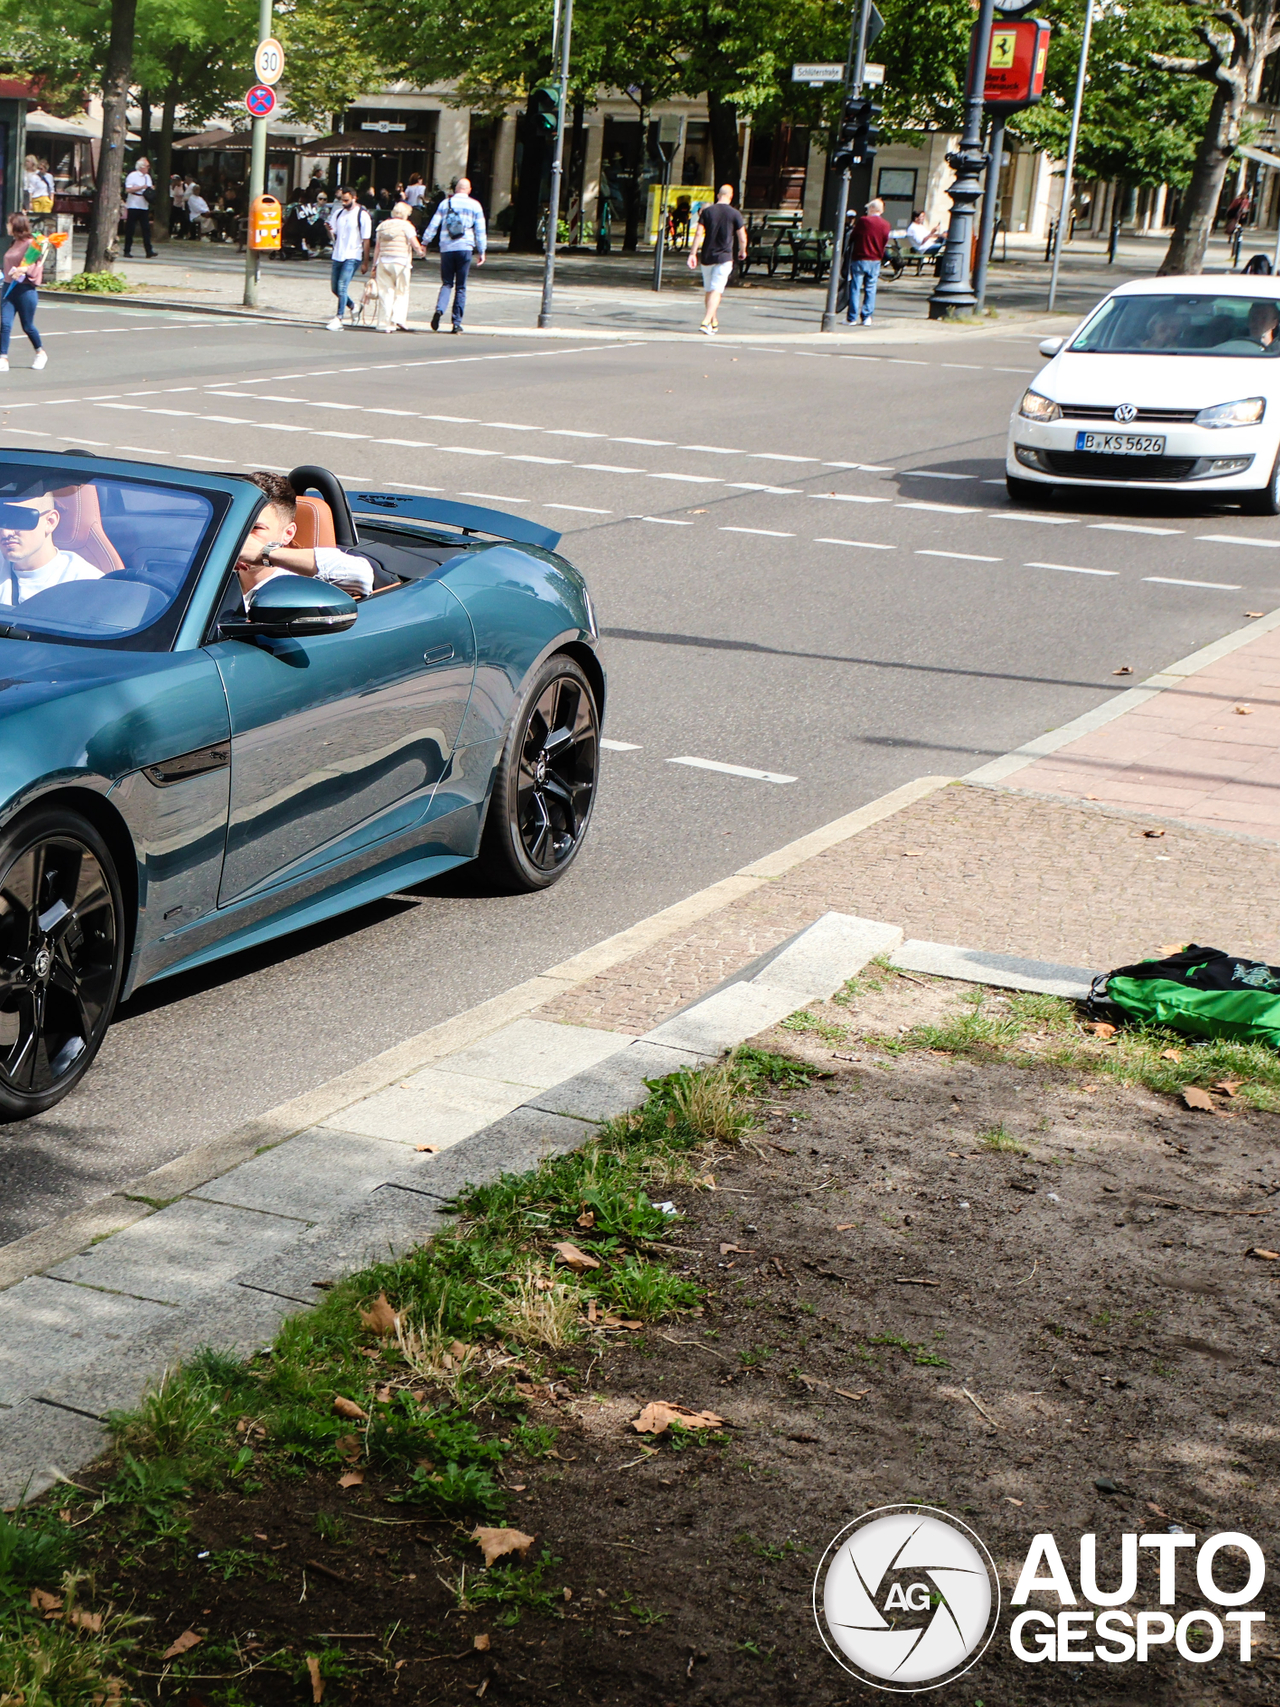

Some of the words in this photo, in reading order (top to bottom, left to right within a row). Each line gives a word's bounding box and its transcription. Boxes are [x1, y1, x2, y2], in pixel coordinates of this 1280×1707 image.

[262, 51, 278, 72] 30
[796, 67, 840, 80] Schlüterstraße
[1085, 435, 1094, 449] B
[1103, 436, 1123, 450] KS
[1126, 437, 1162, 452] 5626
